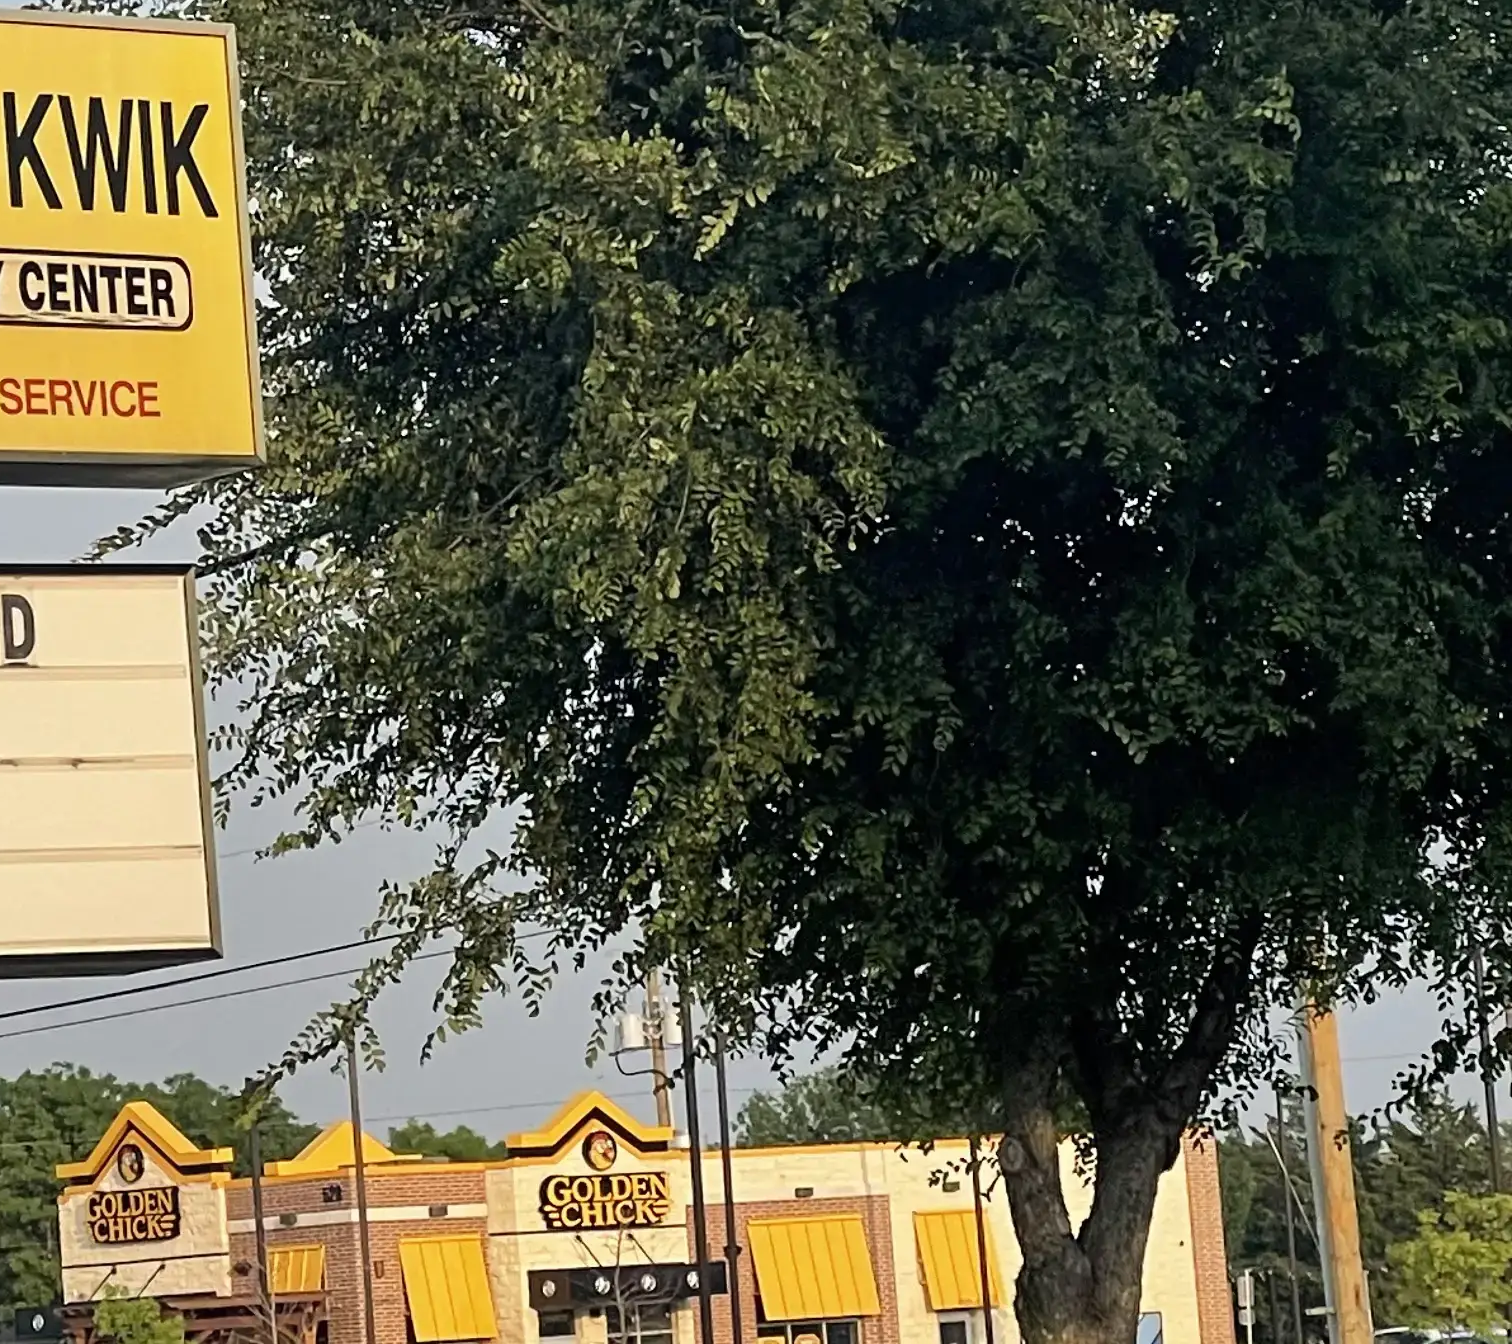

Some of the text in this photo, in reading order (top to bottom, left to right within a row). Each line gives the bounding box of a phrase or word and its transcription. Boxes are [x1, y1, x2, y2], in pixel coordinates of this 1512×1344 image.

[18, 261, 176, 318] CENTER
[0, 378, 161, 418] SERVICE
[87, 1187, 173, 1223] GOLDEN
[547, 1173, 669, 1207] GOLDEN
[94, 1214, 164, 1243] CHICK
[561, 1199, 661, 1227] CHICK
